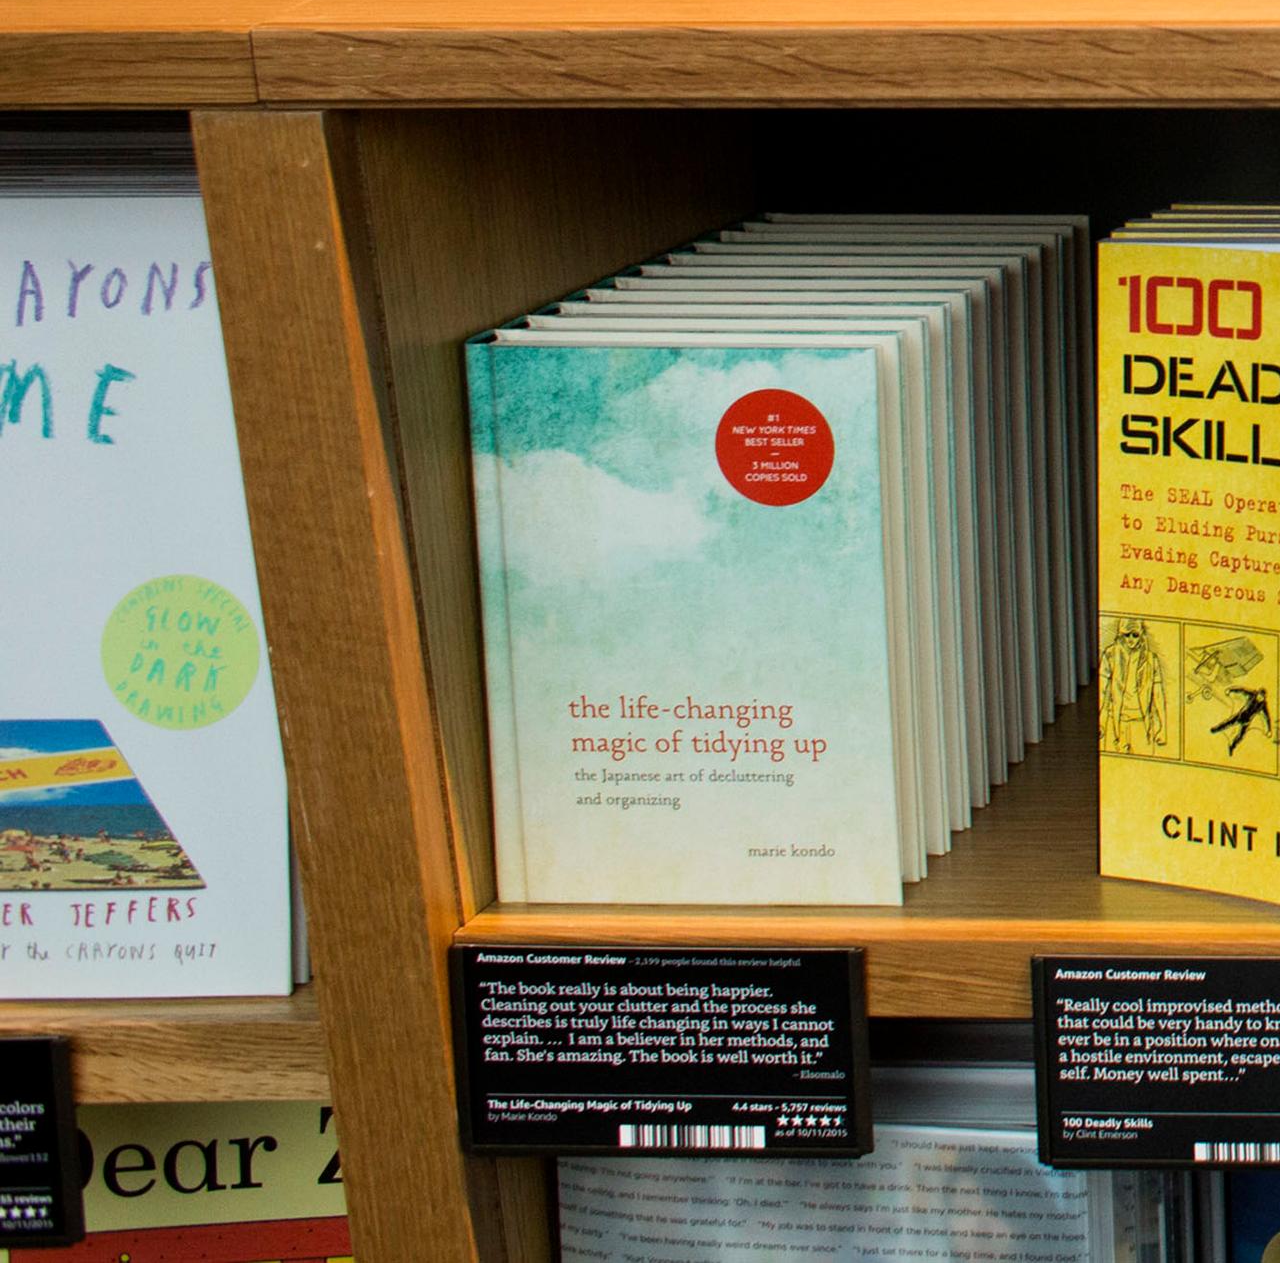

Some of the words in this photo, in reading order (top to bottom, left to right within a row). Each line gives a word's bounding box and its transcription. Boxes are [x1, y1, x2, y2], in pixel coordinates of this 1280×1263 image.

[1118, 275, 1262, 340] 100
[732, 426, 755, 434] NEW
[759, 426, 785, 434] YORK
[787, 426, 817, 434] TIMES
[745, 473, 780, 481] COPIES
[782, 473, 807, 481] SOLD
[1120, 483, 1153, 501] The
[1167, 487, 1213, 507] SEAL
[1121, 513, 1142, 530] to
[1155, 516, 1234, 543] Eluding
[1121, 543, 1198, 569] Evading
[1119, 574, 1153, 594] Any
[1166, 577, 1265, 602] Dangerous
[568, 695, 610, 718] the
[619, 695, 793, 728] life-changing
[571, 731, 646, 761] magic
[655, 729, 683, 753] of
[691, 729, 784, 762] tidying
[793, 738, 826, 762] up
[574, 767, 597, 781] the
[601, 768, 661, 786] Japanese
[665, 772, 684, 782] art
[689, 768, 704, 782] of
[708, 769, 794, 787] decluttering
[576, 791, 602, 805] and
[605, 796, 680, 810] organizing
[1161, 814, 1256, 851] CLINT
[748, 848, 786, 857] marie
[790, 843, 835, 857] kondo
[26, 941, 49, 961] the
[65, 941, 155, 961] CRAYONS
[174, 942, 216, 964] QUIT
[477, 953, 523, 963] Amazon
[526, 953, 581, 963] Customer
[584, 954, 626, 964] Review
[482, 1015, 552, 1029] describes
[555, 1015, 568, 1028] is
[570, 1015, 608, 1031] truly
[611, 1015, 636, 1028] life
[639, 1017, 710, 1033] changing
[712, 1016, 728, 1029] in
[731, 1020, 769, 1033] ways
[772, 1018, 778, 1030] I
[781, 1020, 834, 1031] cannot
[1057, 1014, 1089, 1028] that
[1092, 1017, 1134, 1032] could
[1136, 1015, 1155, 1029] be
[1159, 1019, 1192, 1034] very
[1194, 1015, 1243, 1033] handy
[1245, 1018, 1262, 1030] to
